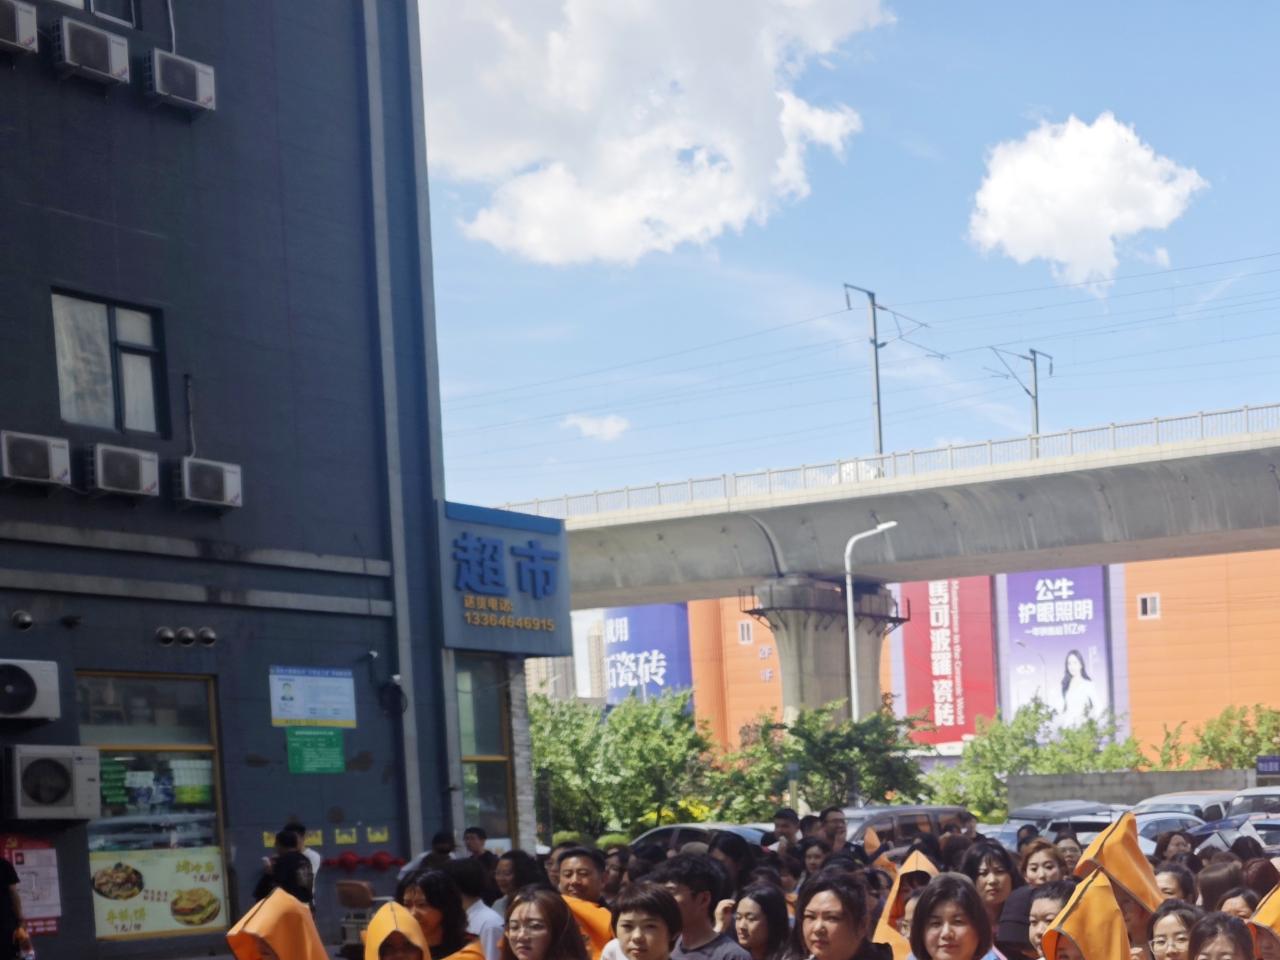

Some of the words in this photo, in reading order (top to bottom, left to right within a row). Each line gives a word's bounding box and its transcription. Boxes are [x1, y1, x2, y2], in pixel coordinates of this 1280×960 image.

[452, 531, 561, 600] 超市
[1035, 577, 1075, 601] 公牛
[1018, 599, 1093, 624] 护眼照明
